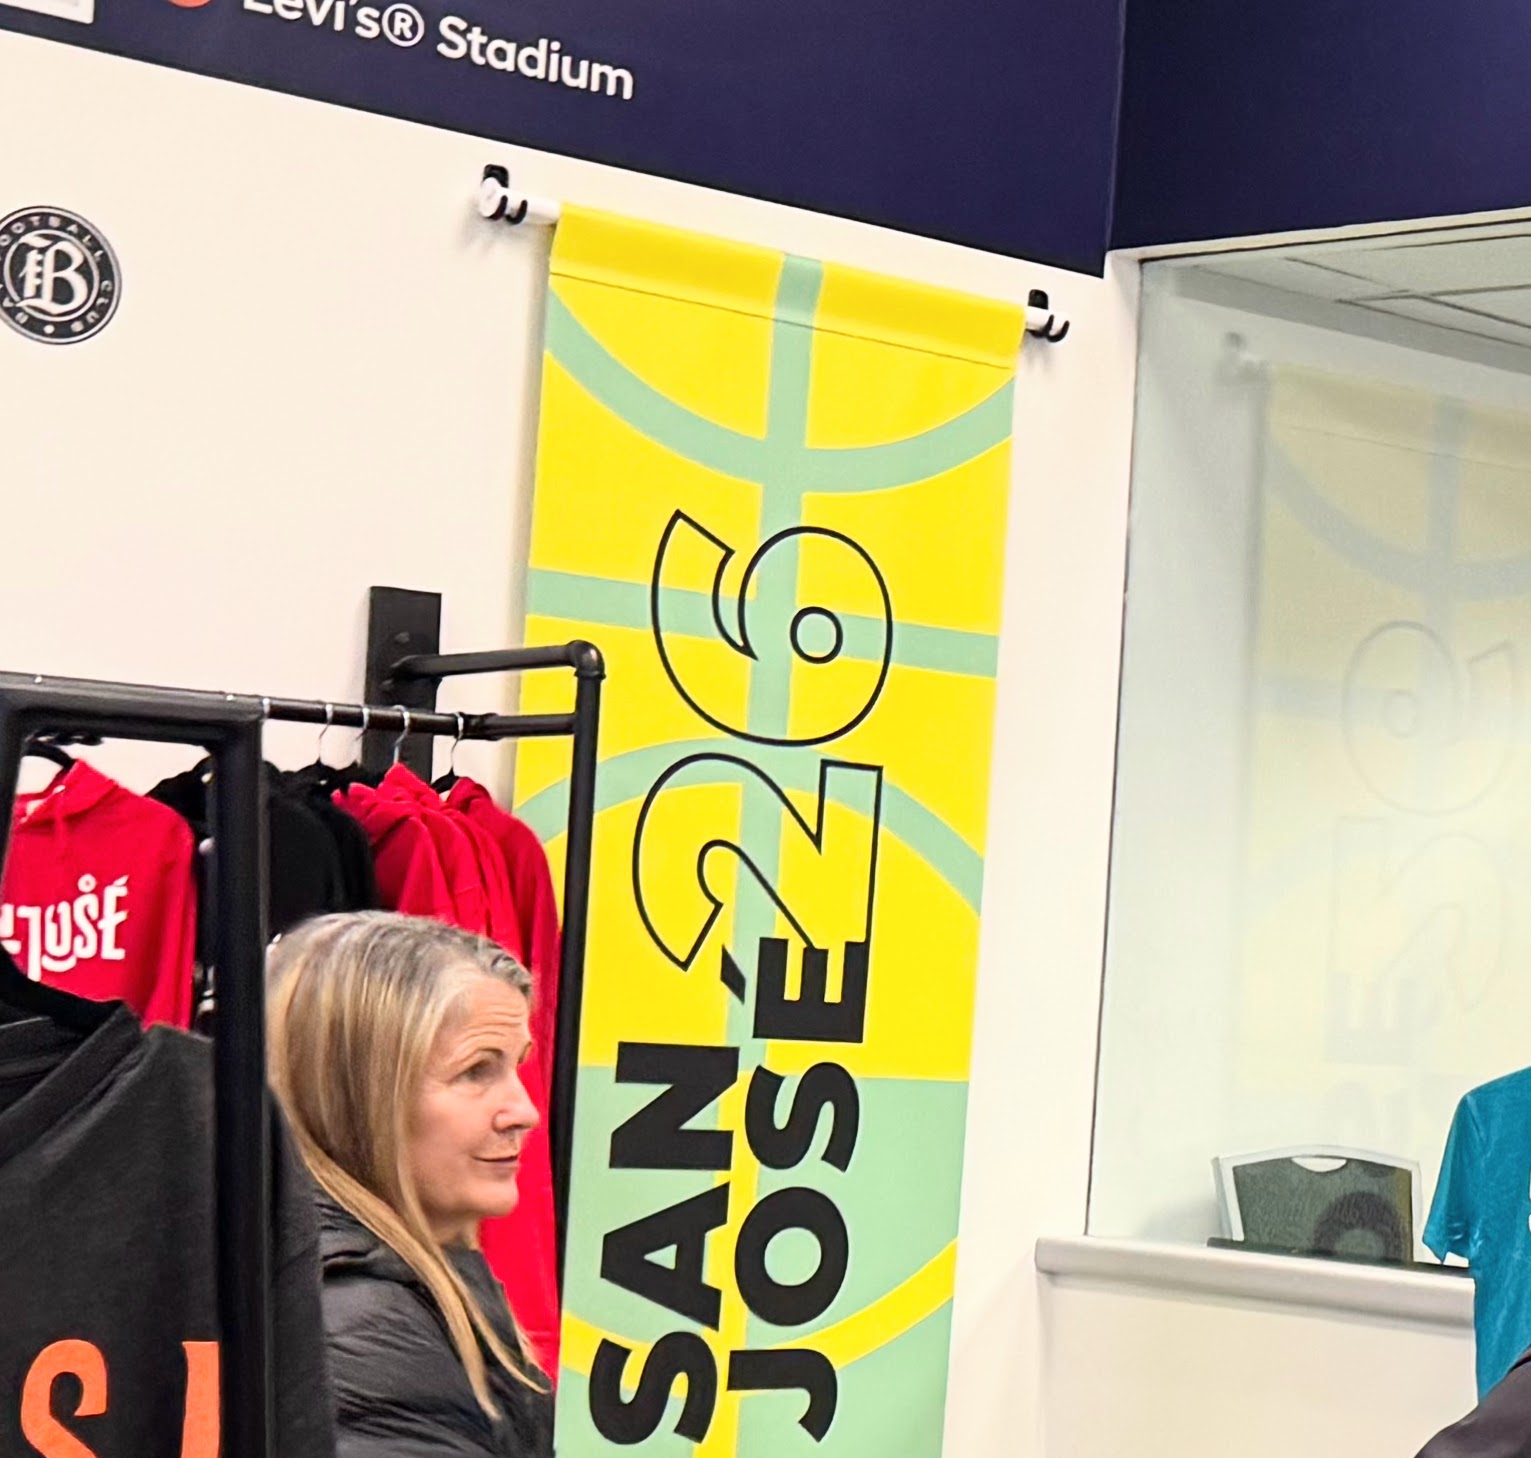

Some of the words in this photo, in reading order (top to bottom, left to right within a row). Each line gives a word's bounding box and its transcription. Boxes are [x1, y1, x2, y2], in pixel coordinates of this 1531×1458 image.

[436, 14, 635, 99] Stadium
[632, 508, 893, 972] 26
[590, 1042, 739, 1446] SAN
[721, 936, 868, 1444] JOSÉ
